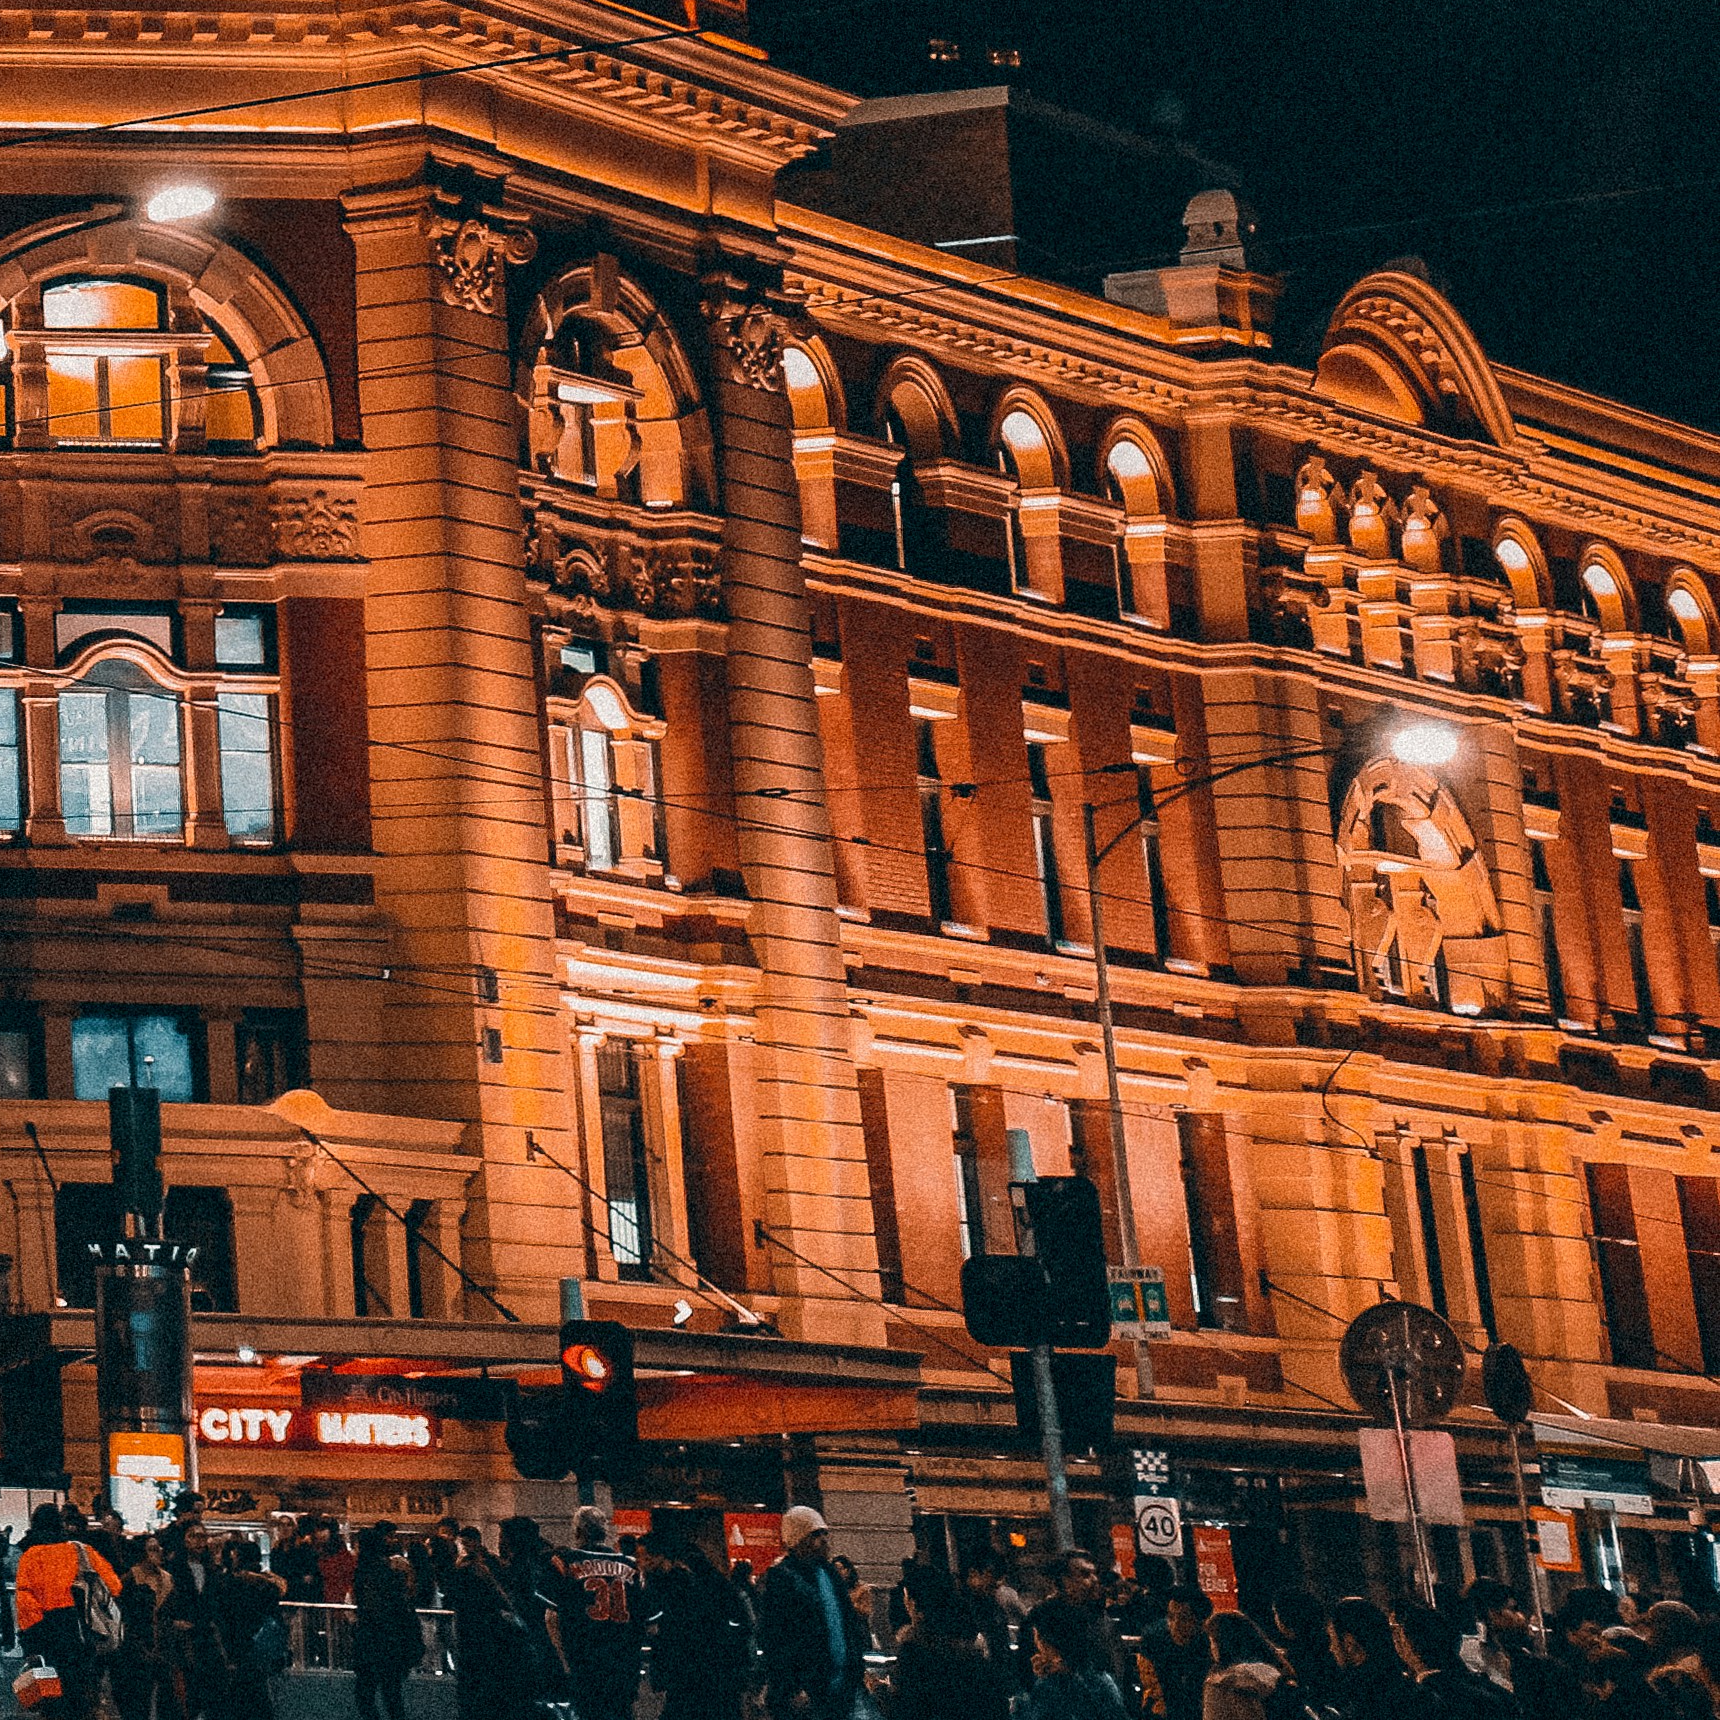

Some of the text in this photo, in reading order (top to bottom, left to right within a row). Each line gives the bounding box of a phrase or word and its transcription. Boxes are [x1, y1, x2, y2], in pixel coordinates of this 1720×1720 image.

[200, 1408, 292, 1443] CITY
[1145, 1516, 1175, 1538] 40
[584, 1577, 631, 1623] 31
